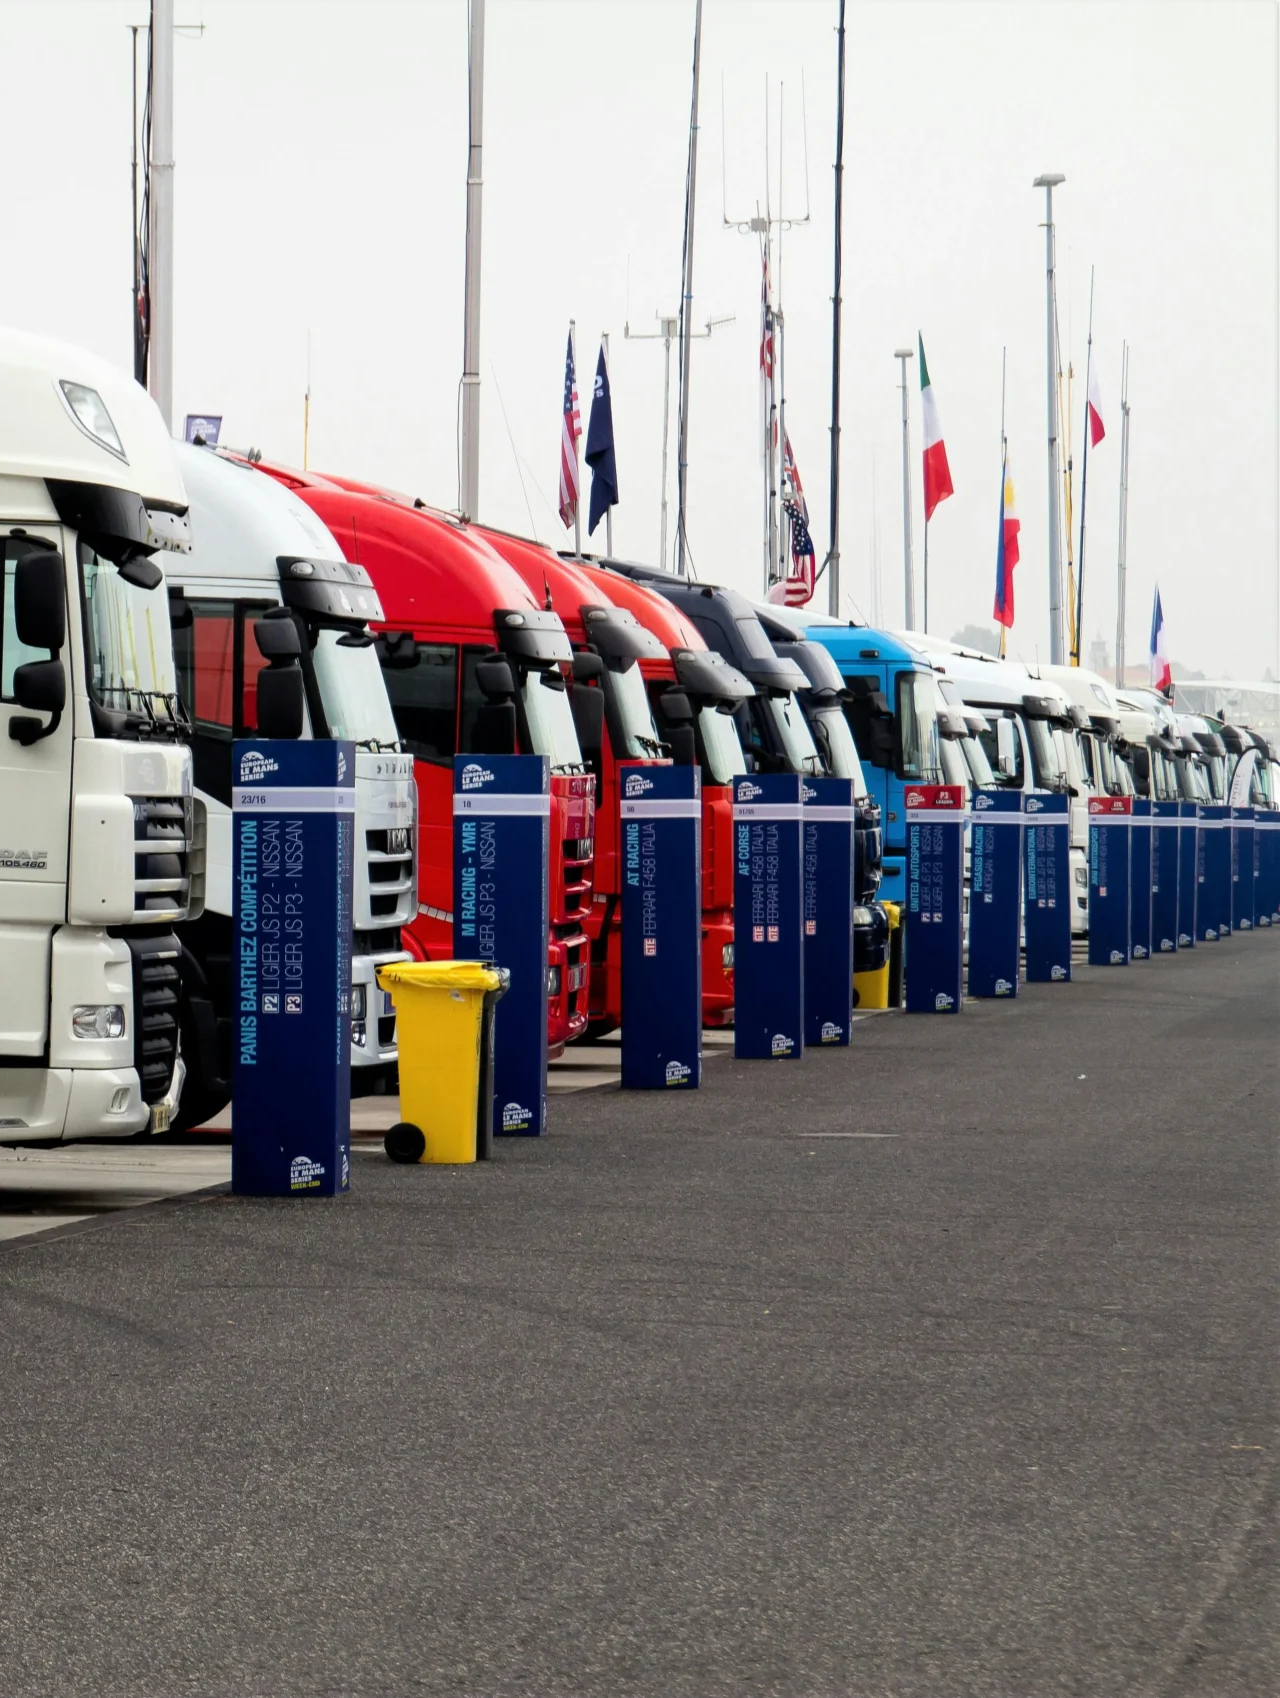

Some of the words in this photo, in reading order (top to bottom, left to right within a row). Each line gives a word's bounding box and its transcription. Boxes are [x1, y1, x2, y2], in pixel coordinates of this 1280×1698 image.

[240, 757, 274, 769] EUROPEAN
[240, 767, 250, 776] LE
[252, 762, 279, 773] MANS
[240, 772, 265, 782] SERIES
[472, 774, 495, 783] MANS
[241, 795, 266, 805] 23/16
[940, 791, 949, 799] P3
[462, 821, 476, 854] YMR
[480, 821, 496, 870] NISSAN
[626, 823, 639, 868] RACING
[642, 822, 655, 855] ITALIA
[738, 825, 750, 860] CORSE
[262, 820, 280, 877] NISSAN
[285, 820, 303, 877] NISSAN
[910, 825, 920, 880] AUTOSPORTS
[0, 860, 46, 869] 105.460
[738, 862, 750, 876] AF
[237, 820, 257, 932] COMPÉTITION
[627, 871, 640, 886] AT
[461, 867, 476, 920] RACING
[479, 883, 495, 901] P3
[910, 881, 919, 912] UNITED
[262, 893, 280, 914] P2
[285, 893, 303, 914] P3
[479, 904, 495, 922] JS
[643, 890, 657, 936] FERRARI
[262, 918, 280, 939] JS
[285, 918, 303, 939] JS
[461, 923, 475, 936] M
[240, 936, 257, 1011] BARTHEZ
[262, 943, 280, 989] LIGIER
[285, 943, 303, 989] LIGIER
[264, 995, 278, 1012] P2
[287, 995, 301, 1012] P3
[240, 1015, 257, 1065] PANIS
[290, 1170, 299, 1178] LE
[301, 1167, 325, 1176] MANS
